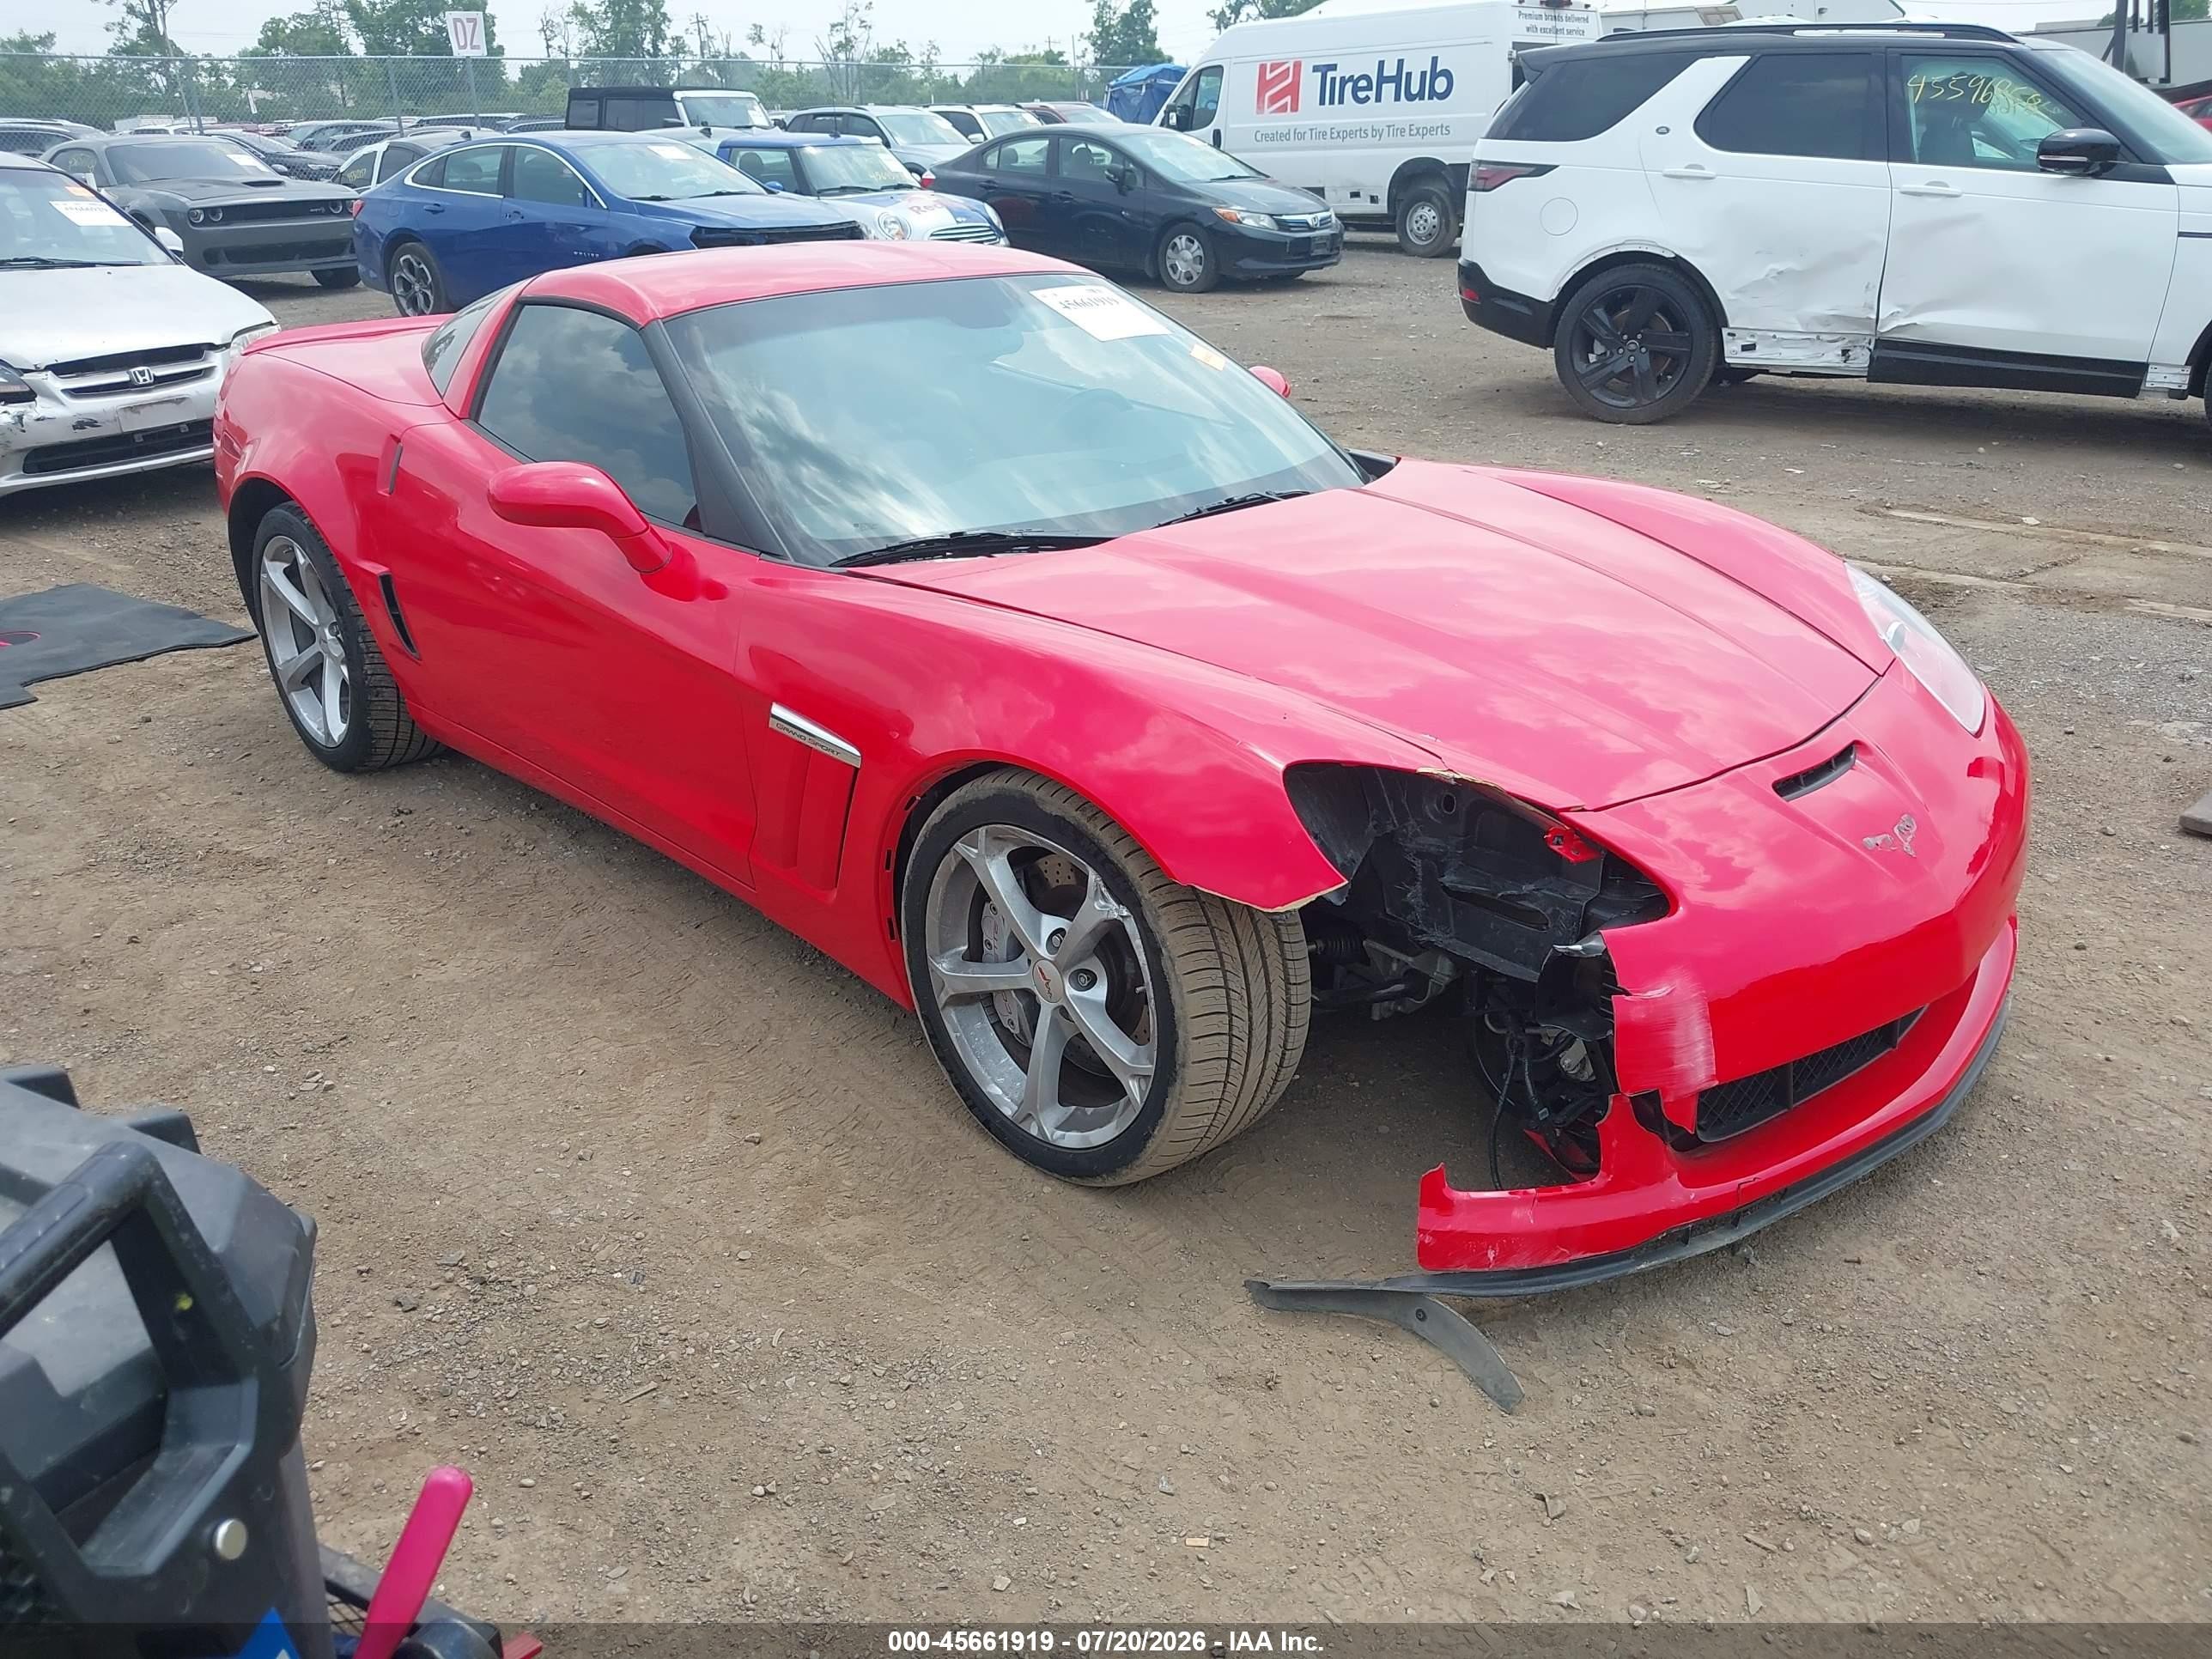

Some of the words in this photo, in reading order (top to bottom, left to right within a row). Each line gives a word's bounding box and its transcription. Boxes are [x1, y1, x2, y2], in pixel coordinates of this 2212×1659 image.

[1518, 10, 1543, 21] Premium
[1545, 13, 1563, 22] brands
[1565, 14, 1589, 23] delivered
[452, 17, 482, 50] DZ
[1526, 24, 1538, 33] with
[1540, 27, 1565, 35] excellent
[1566, 27, 1585, 36] service
[1312, 56, 1454, 106] TireHub
[1254, 130, 1291, 143] Created
[1293, 128, 1307, 141] for
[1309, 127, 1328, 141] Tire
[1330, 126, 1369, 143] Experts
[1371, 125, 1384, 141] by
[1386, 124, 1406, 137] Tire
[1408, 123, 1450, 140] Experts
[775, 722, 806, 741] GRAND
[808, 738, 841, 756] SPORT
